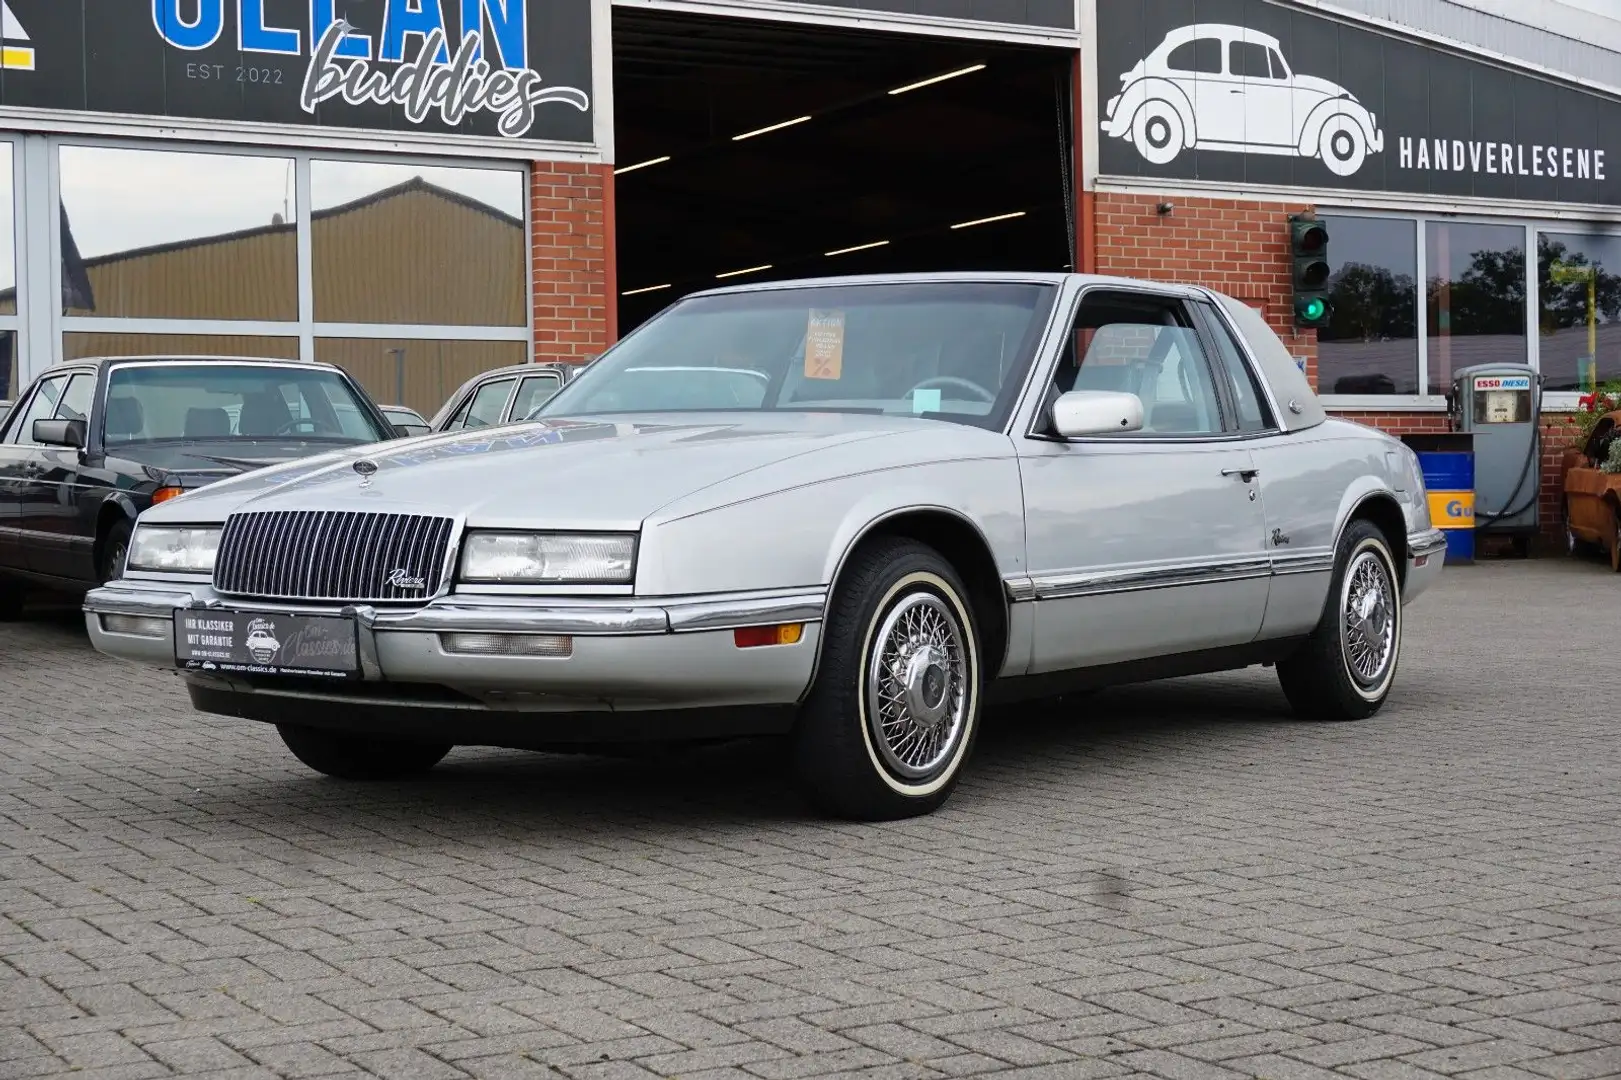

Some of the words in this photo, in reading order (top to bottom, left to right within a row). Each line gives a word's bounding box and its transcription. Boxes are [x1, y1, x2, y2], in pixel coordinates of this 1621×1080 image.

[186, 63, 224, 80] EST
[236, 66, 283, 84] 2022
[300, 19, 588, 137] buddies
[1399, 136, 1606, 181] HANDVERLESENE
[1477, 380, 1500, 388] ESSO
[385, 568, 425, 586] Riviera
[185, 618, 197, 629] IHR
[197, 619, 234, 632] KLASSIKER
[187, 634, 200, 645] MIT
[200, 635, 234, 647] GARANTIE
[220, 662, 277, 674] www.om-classics.de
